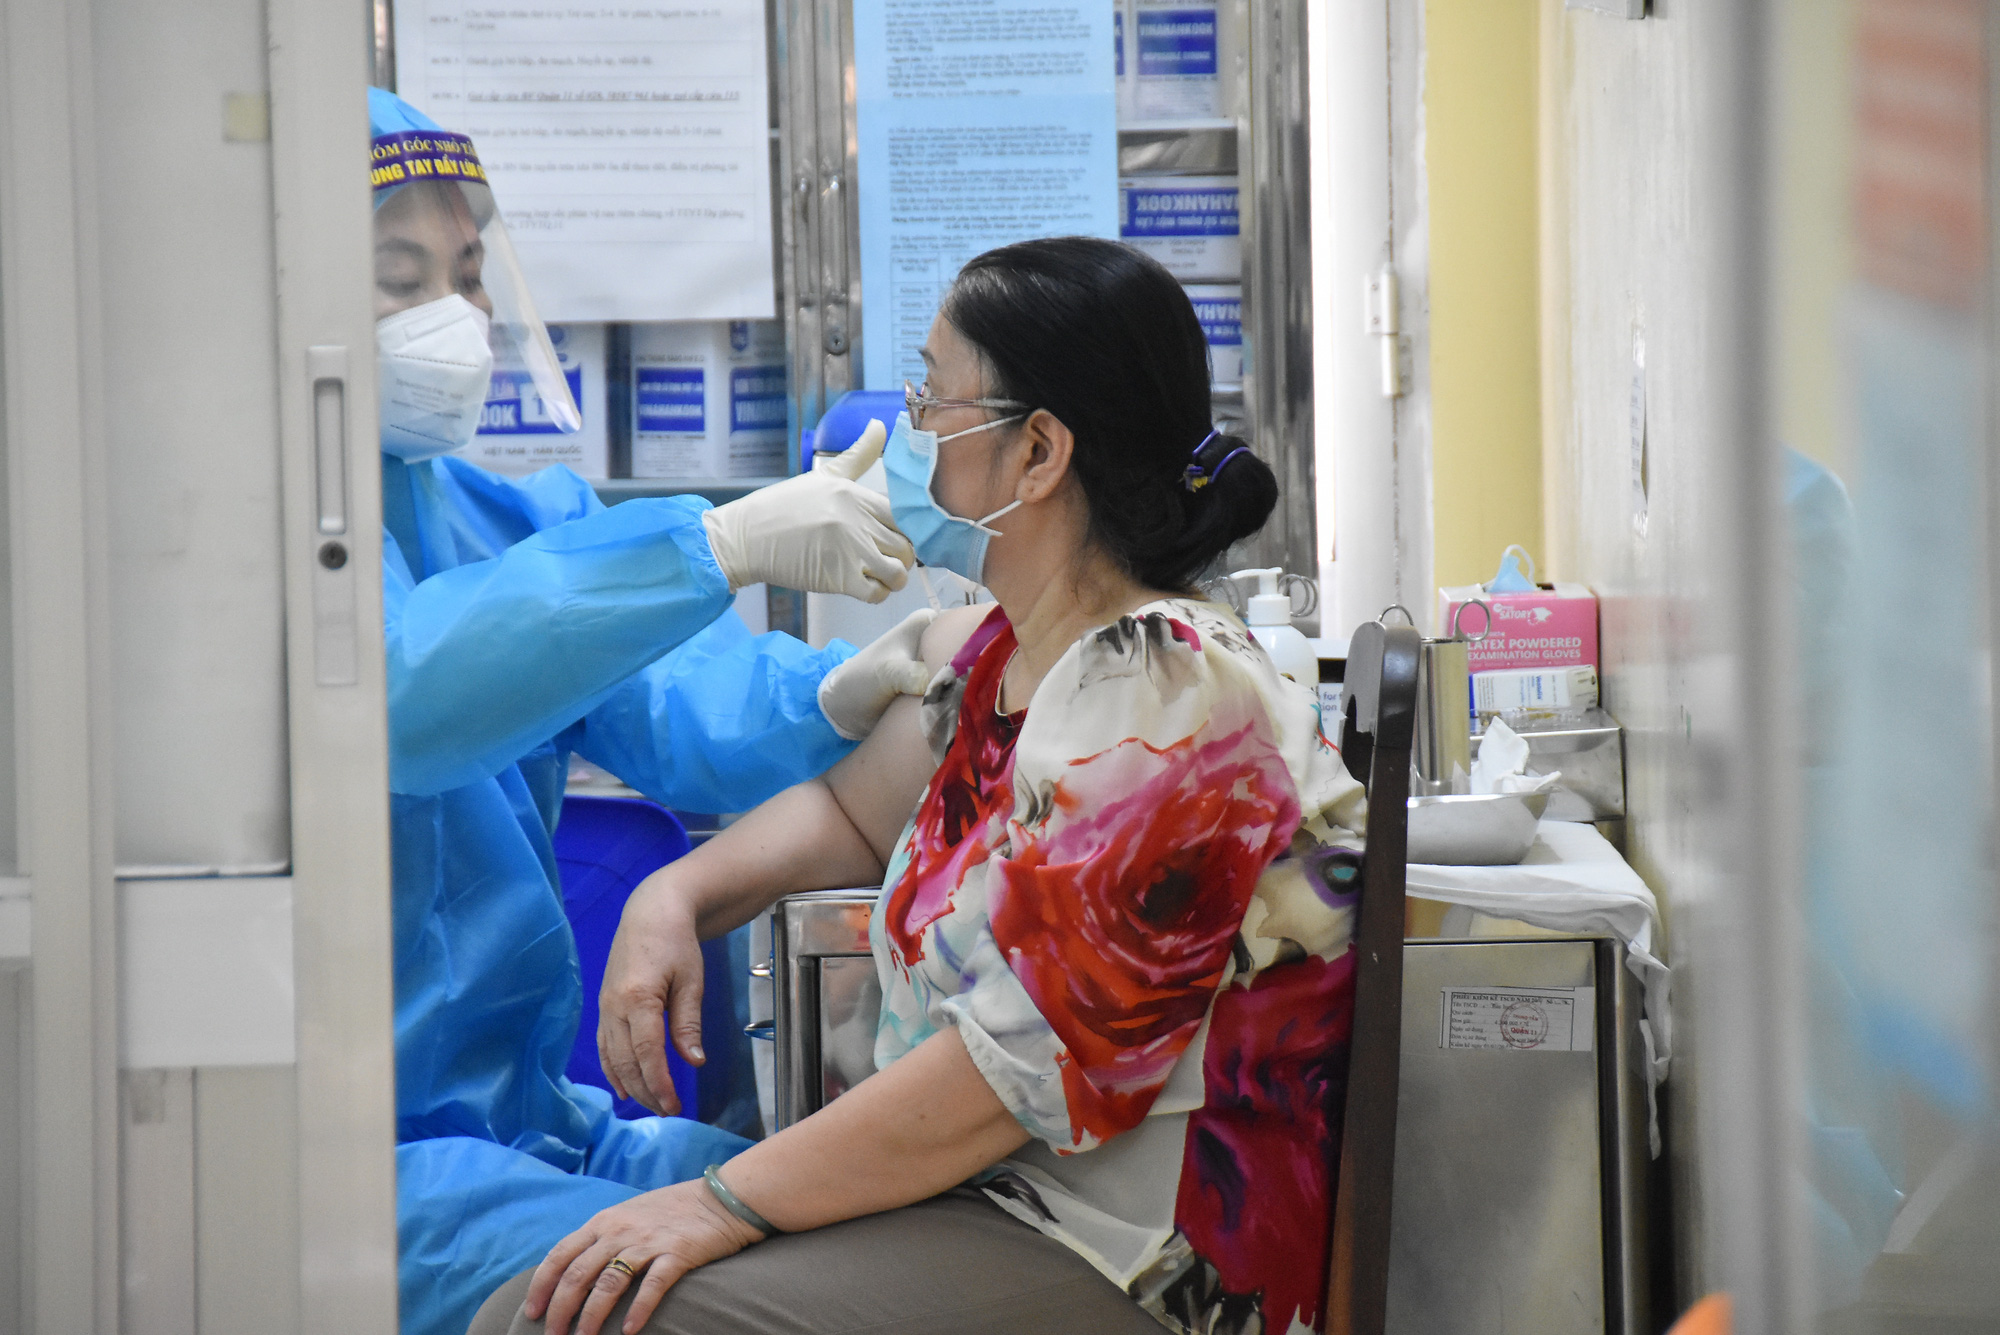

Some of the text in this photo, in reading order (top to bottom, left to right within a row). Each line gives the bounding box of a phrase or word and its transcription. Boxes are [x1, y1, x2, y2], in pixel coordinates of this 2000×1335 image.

[404, 157, 434, 177] TAY
[433, 153, 460, 176] ĐẨY
[1499, 609, 1533, 621] SATORY
[1467, 636, 1583, 651] LATEX POWDERED
[1467, 648, 1582, 661] EXAMINATION GLOVES
[1323, 691, 1338, 702] for
